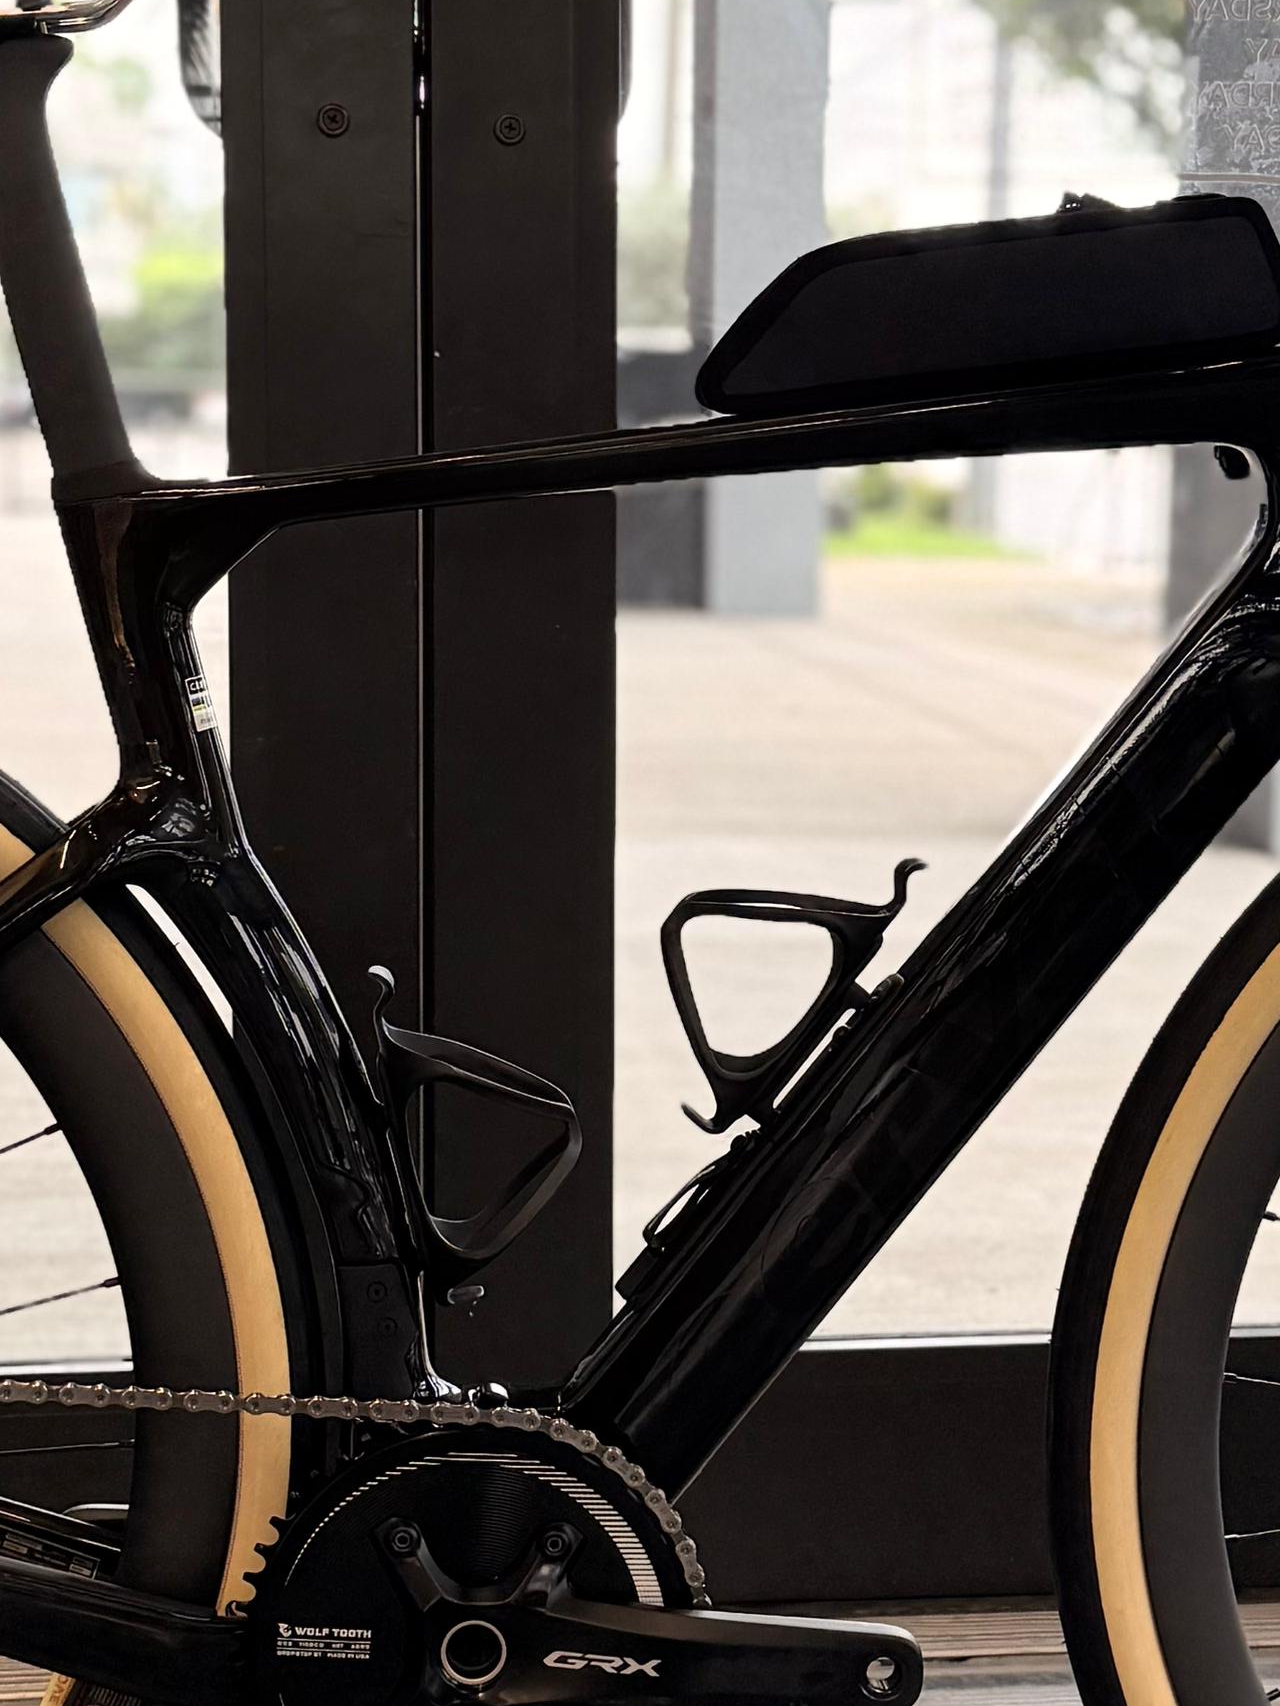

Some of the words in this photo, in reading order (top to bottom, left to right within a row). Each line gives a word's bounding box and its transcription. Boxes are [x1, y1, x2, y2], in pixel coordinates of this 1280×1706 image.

[294, 1626, 330, 1637] WOLF
[331, 1628, 372, 1639] TOOTH
[542, 1649, 661, 1678] GRX
